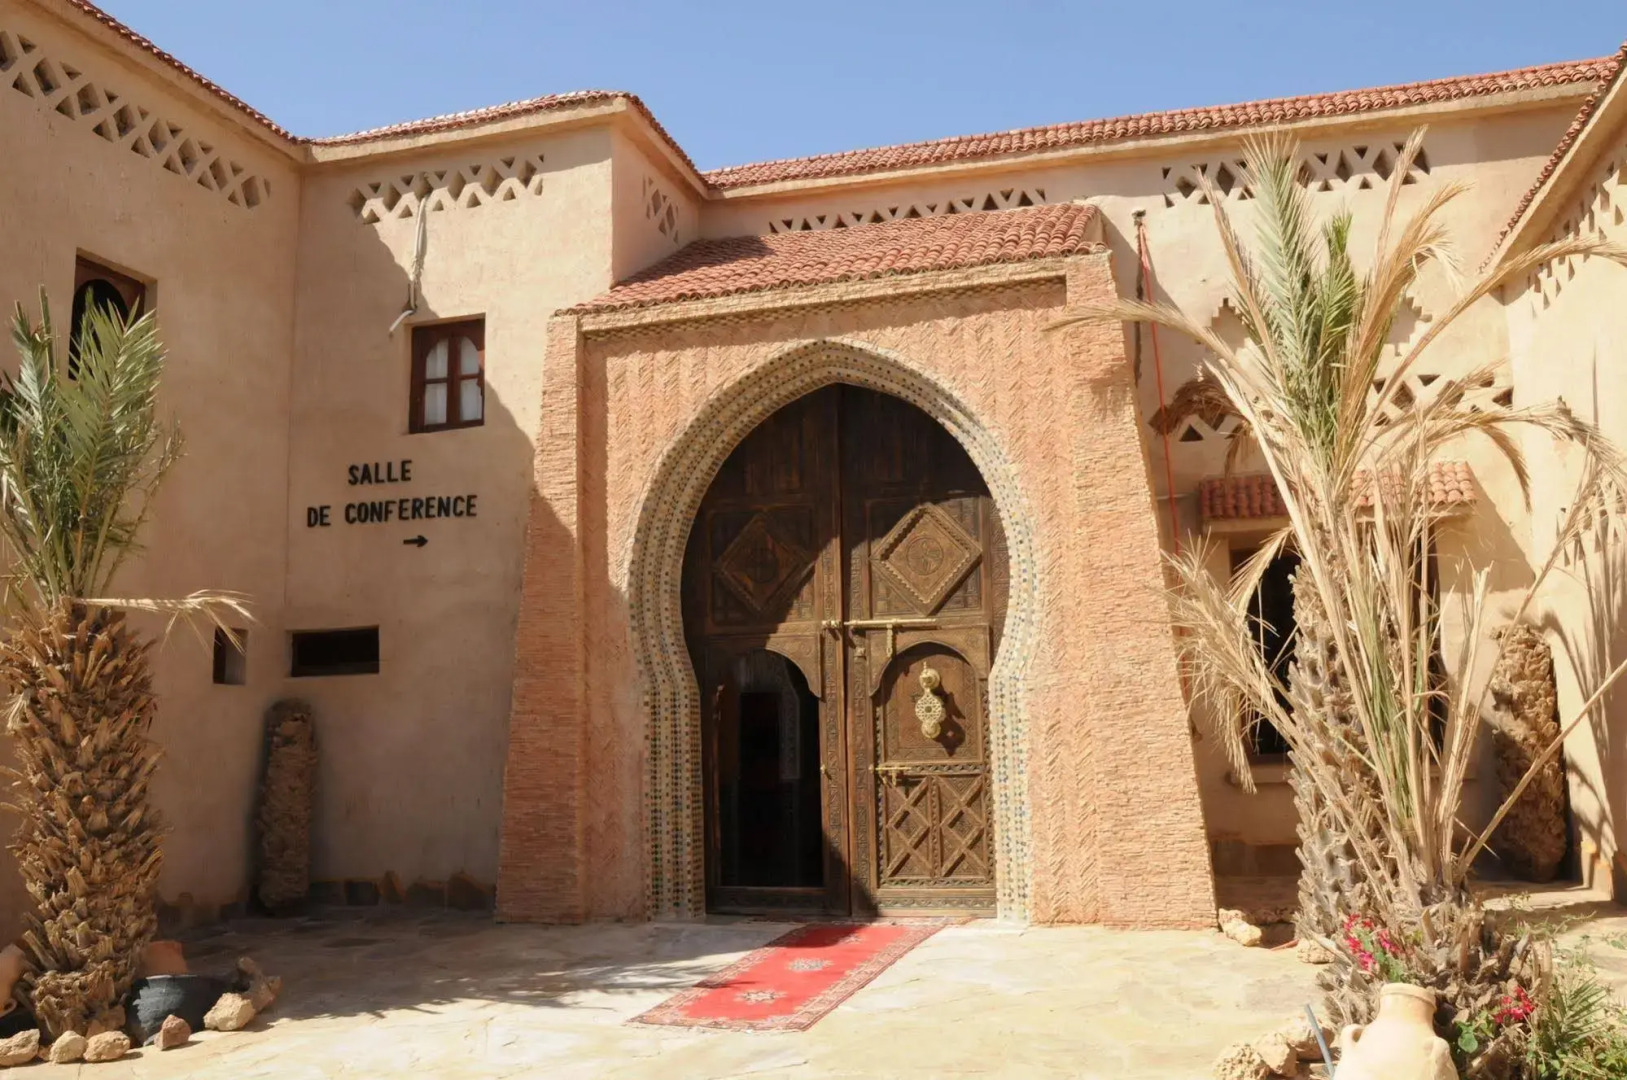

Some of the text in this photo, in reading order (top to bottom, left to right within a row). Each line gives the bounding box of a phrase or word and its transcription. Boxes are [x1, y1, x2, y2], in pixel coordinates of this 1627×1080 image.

[348, 460, 412, 486] SALLE
[307, 495, 477, 528] DE CONFERENCE
